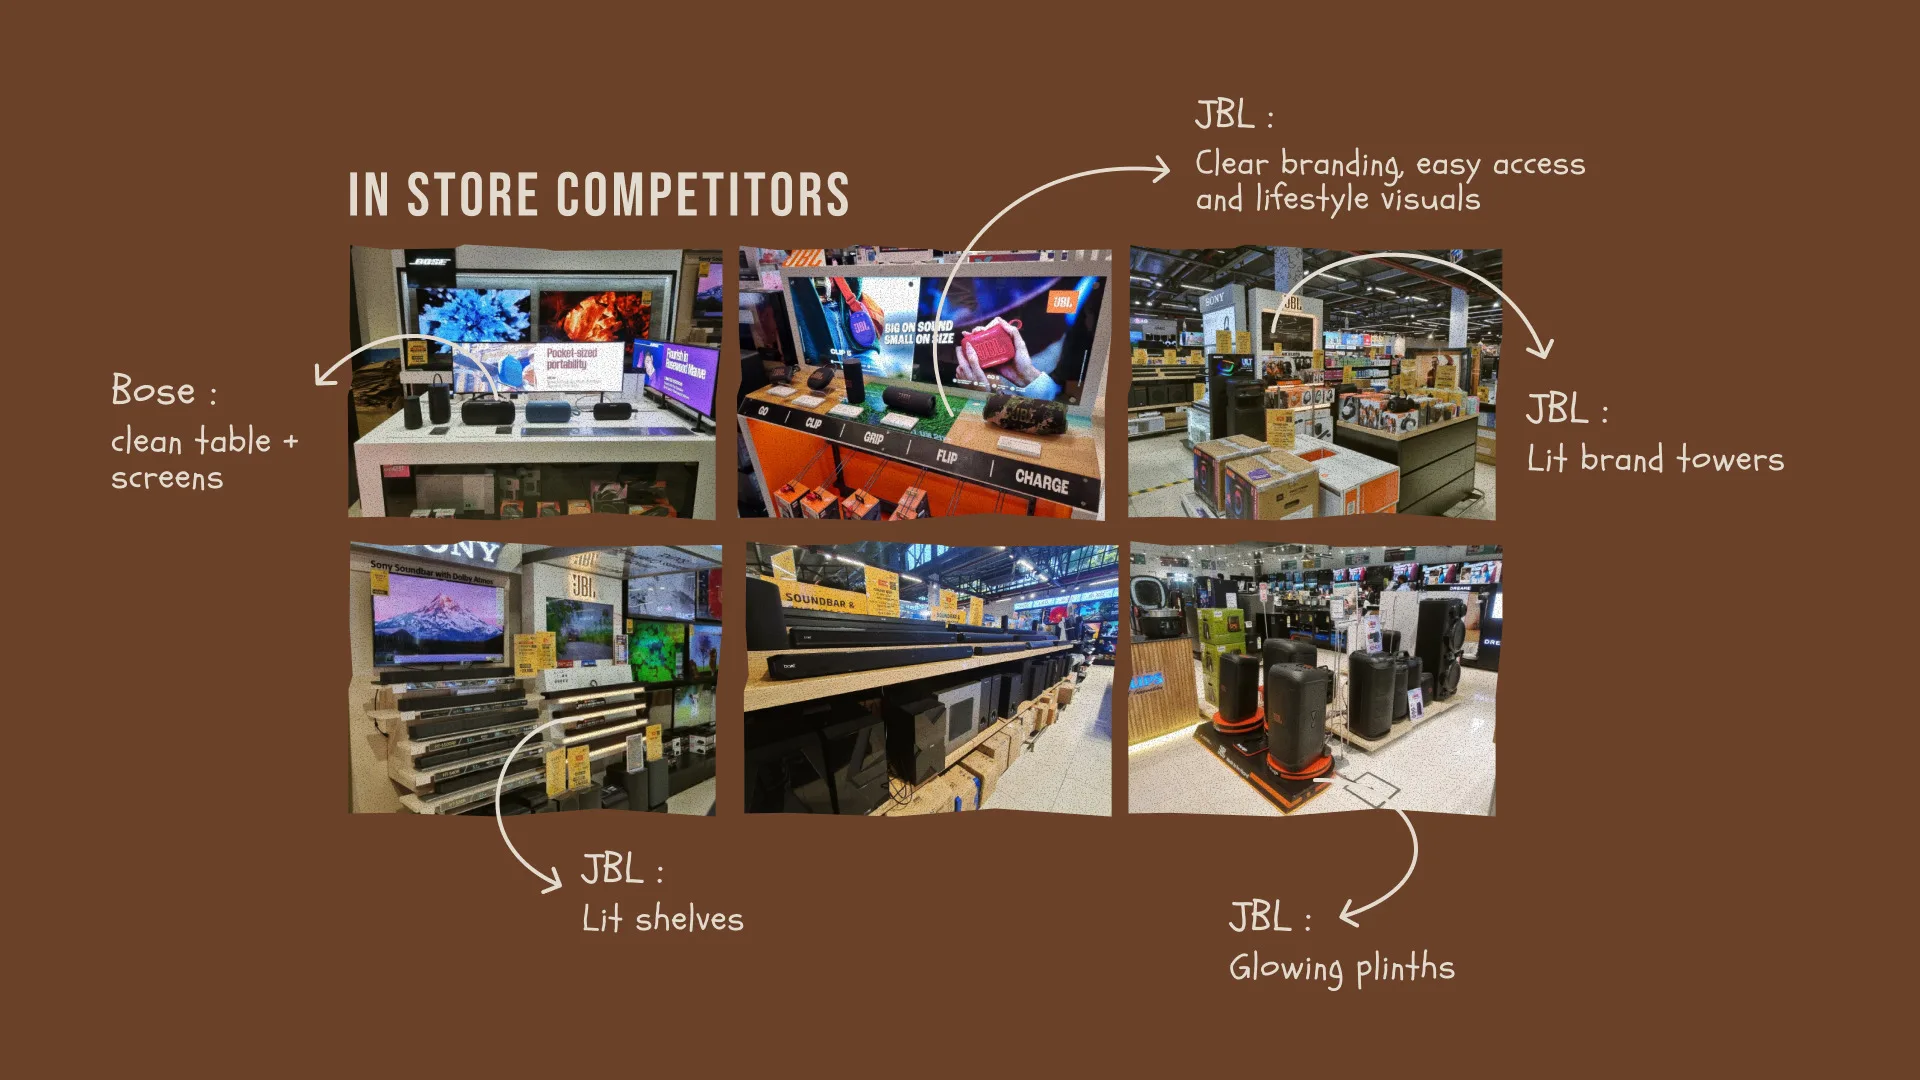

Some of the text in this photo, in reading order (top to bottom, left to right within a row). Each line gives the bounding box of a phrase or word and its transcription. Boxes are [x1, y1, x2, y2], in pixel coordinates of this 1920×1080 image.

[409, 258, 451, 266] BOSE
[1053, 296, 1073, 308] JBL
[1205, 292, 1225, 307] SONY
[1283, 294, 1302, 310] JBL
[853, 321, 871, 334] JBL
[885, 320, 954, 334] BIG ON SOUND
[884, 334, 914, 345] SMALL
[915, 333, 931, 345] ON
[547, 347, 598, 358] Pocket-sized
[830, 348, 846, 356] CLIP
[547, 358, 587, 370] portability
[758, 405, 769, 416] GO
[805, 417, 823, 429] CLIP
[863, 431, 885, 445] GRIP
[936, 448, 958, 464] FLIP
[1015, 468, 1070, 495] CHARGE
[370, 560, 494, 585] Sony Soundbar with Dolby Atmos
[572, 573, 596, 598] JBL
[785, 592, 855, 609] SOUNDBAR &
